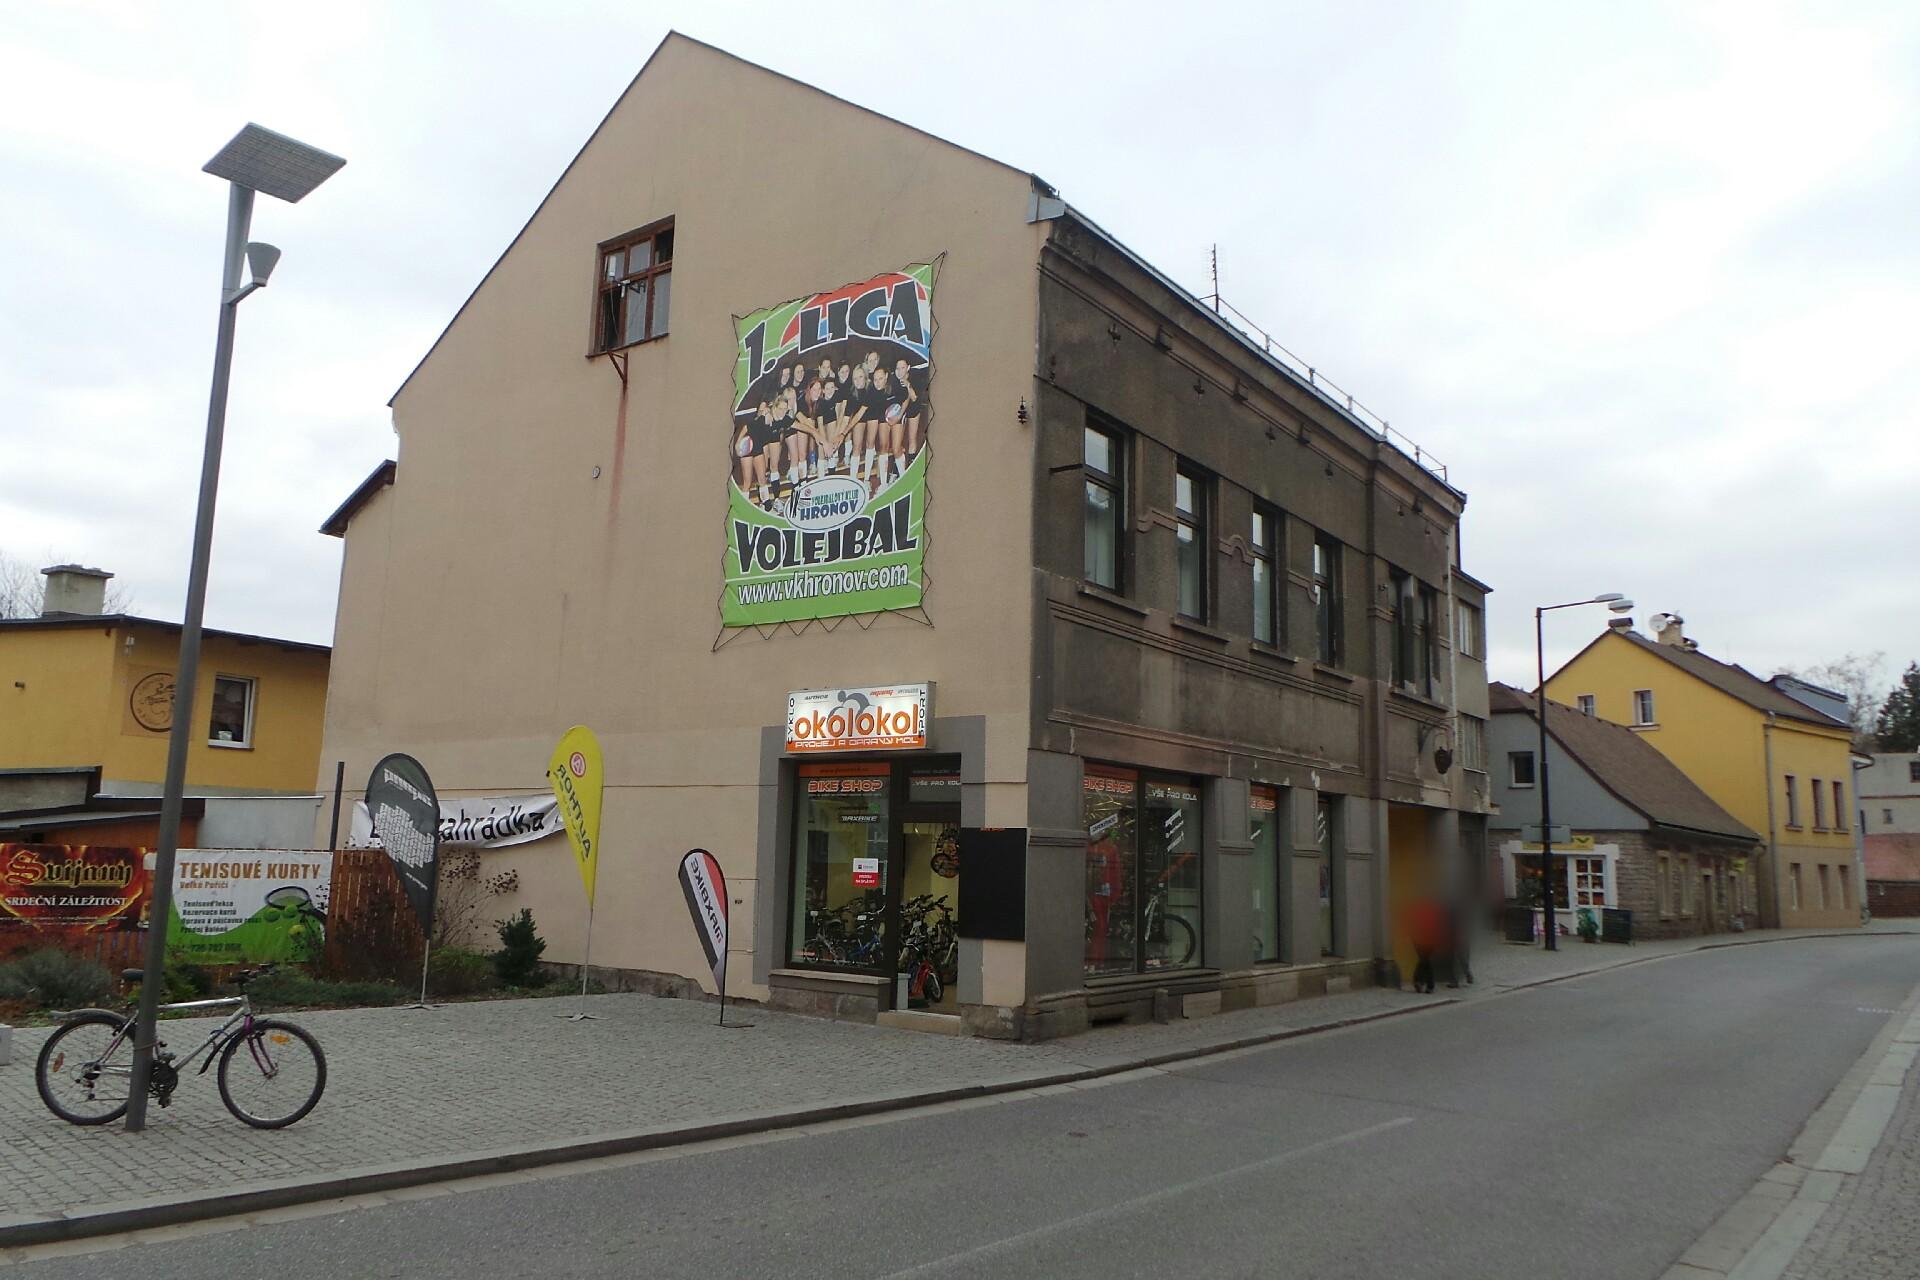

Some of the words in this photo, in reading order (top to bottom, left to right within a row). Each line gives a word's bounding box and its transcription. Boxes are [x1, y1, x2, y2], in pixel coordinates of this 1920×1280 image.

[744, 320, 778, 384] 1.
[798, 279, 926, 354] LIGA
[800, 500, 859, 521] HRONOV
[734, 492, 919, 574] VOLEJBAL
[738, 563, 909, 605] www.vkhronov.com
[787, 697, 795, 744] CYKLO
[794, 703, 919, 739] okolokol
[795, 740, 836, 748] PRODEJ
[848, 737, 894, 746] OPRAVY
[895, 736, 918, 744] KOL
[807, 780, 840, 793] BIKE
[840, 779, 883, 792] SHOP
[179, 860, 261, 879] TENISOVÉ
[267, 863, 321, 879] KURTY
[5, 894, 57, 906] SRDEČNÍ
[60, 894, 128, 906] ZÁLEŽITOST
